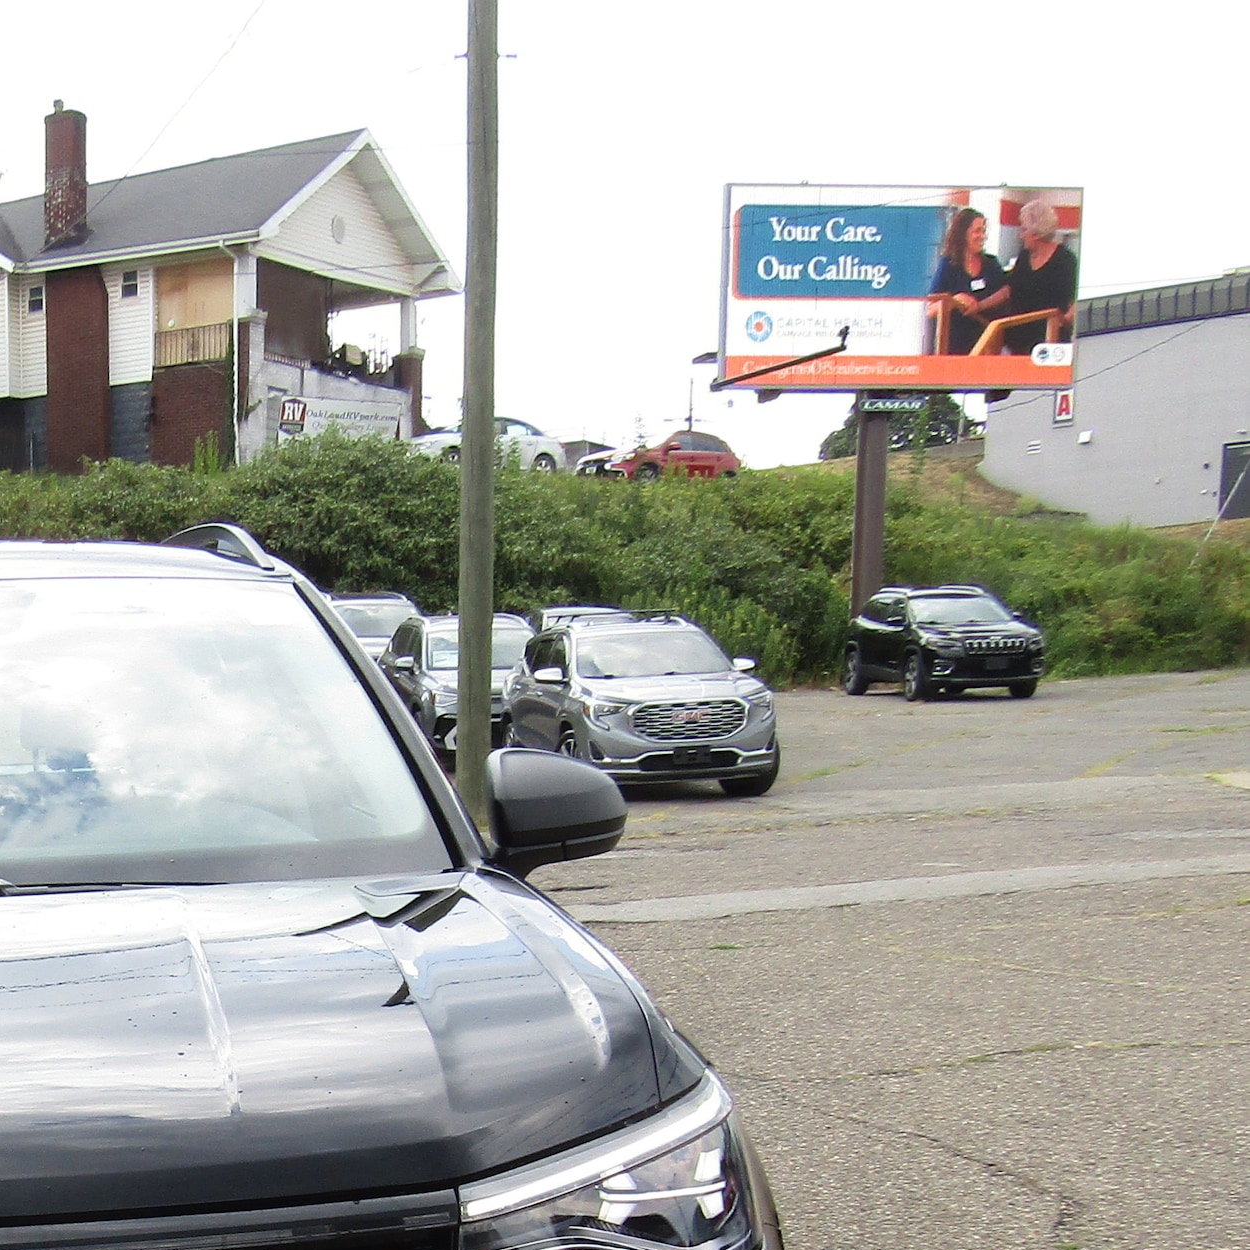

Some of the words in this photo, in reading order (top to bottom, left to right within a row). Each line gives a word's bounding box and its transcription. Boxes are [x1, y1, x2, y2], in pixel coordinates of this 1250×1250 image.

[770, 216, 821, 242] Your
[825, 216, 883, 243] Care.
[757, 255, 804, 281] Our
[776, 317, 829, 329] CAPITAL
[834, 316, 883, 328] HEALTH
[283, 402, 304, 420] RV
[864, 401, 922, 409] LAMAR
[1057, 394, 1071, 416] A
[671, 709, 711, 722] GMC
